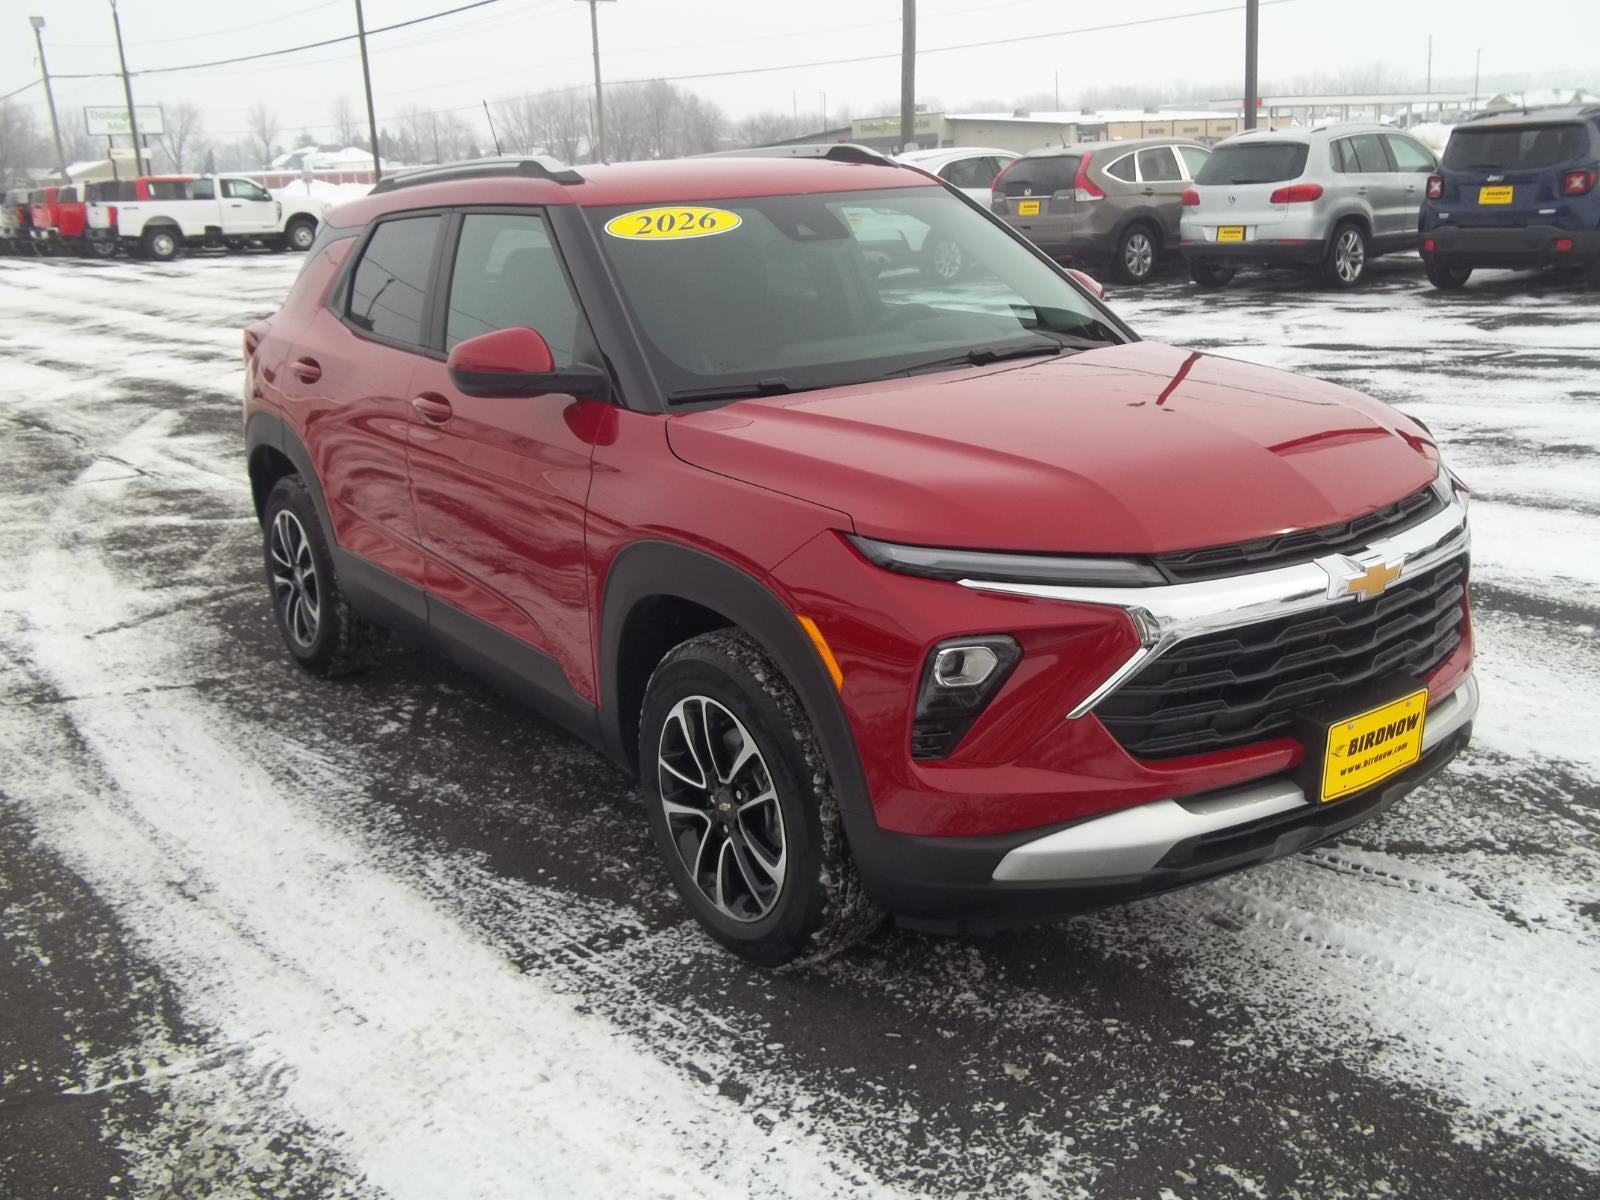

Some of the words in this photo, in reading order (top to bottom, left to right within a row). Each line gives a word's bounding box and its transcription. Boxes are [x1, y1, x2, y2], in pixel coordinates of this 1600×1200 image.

[635, 211, 717, 235] 2026
[1347, 711, 1420, 757] BIRDNOW
[1340, 742, 1408, 776] www.birdnow.com
